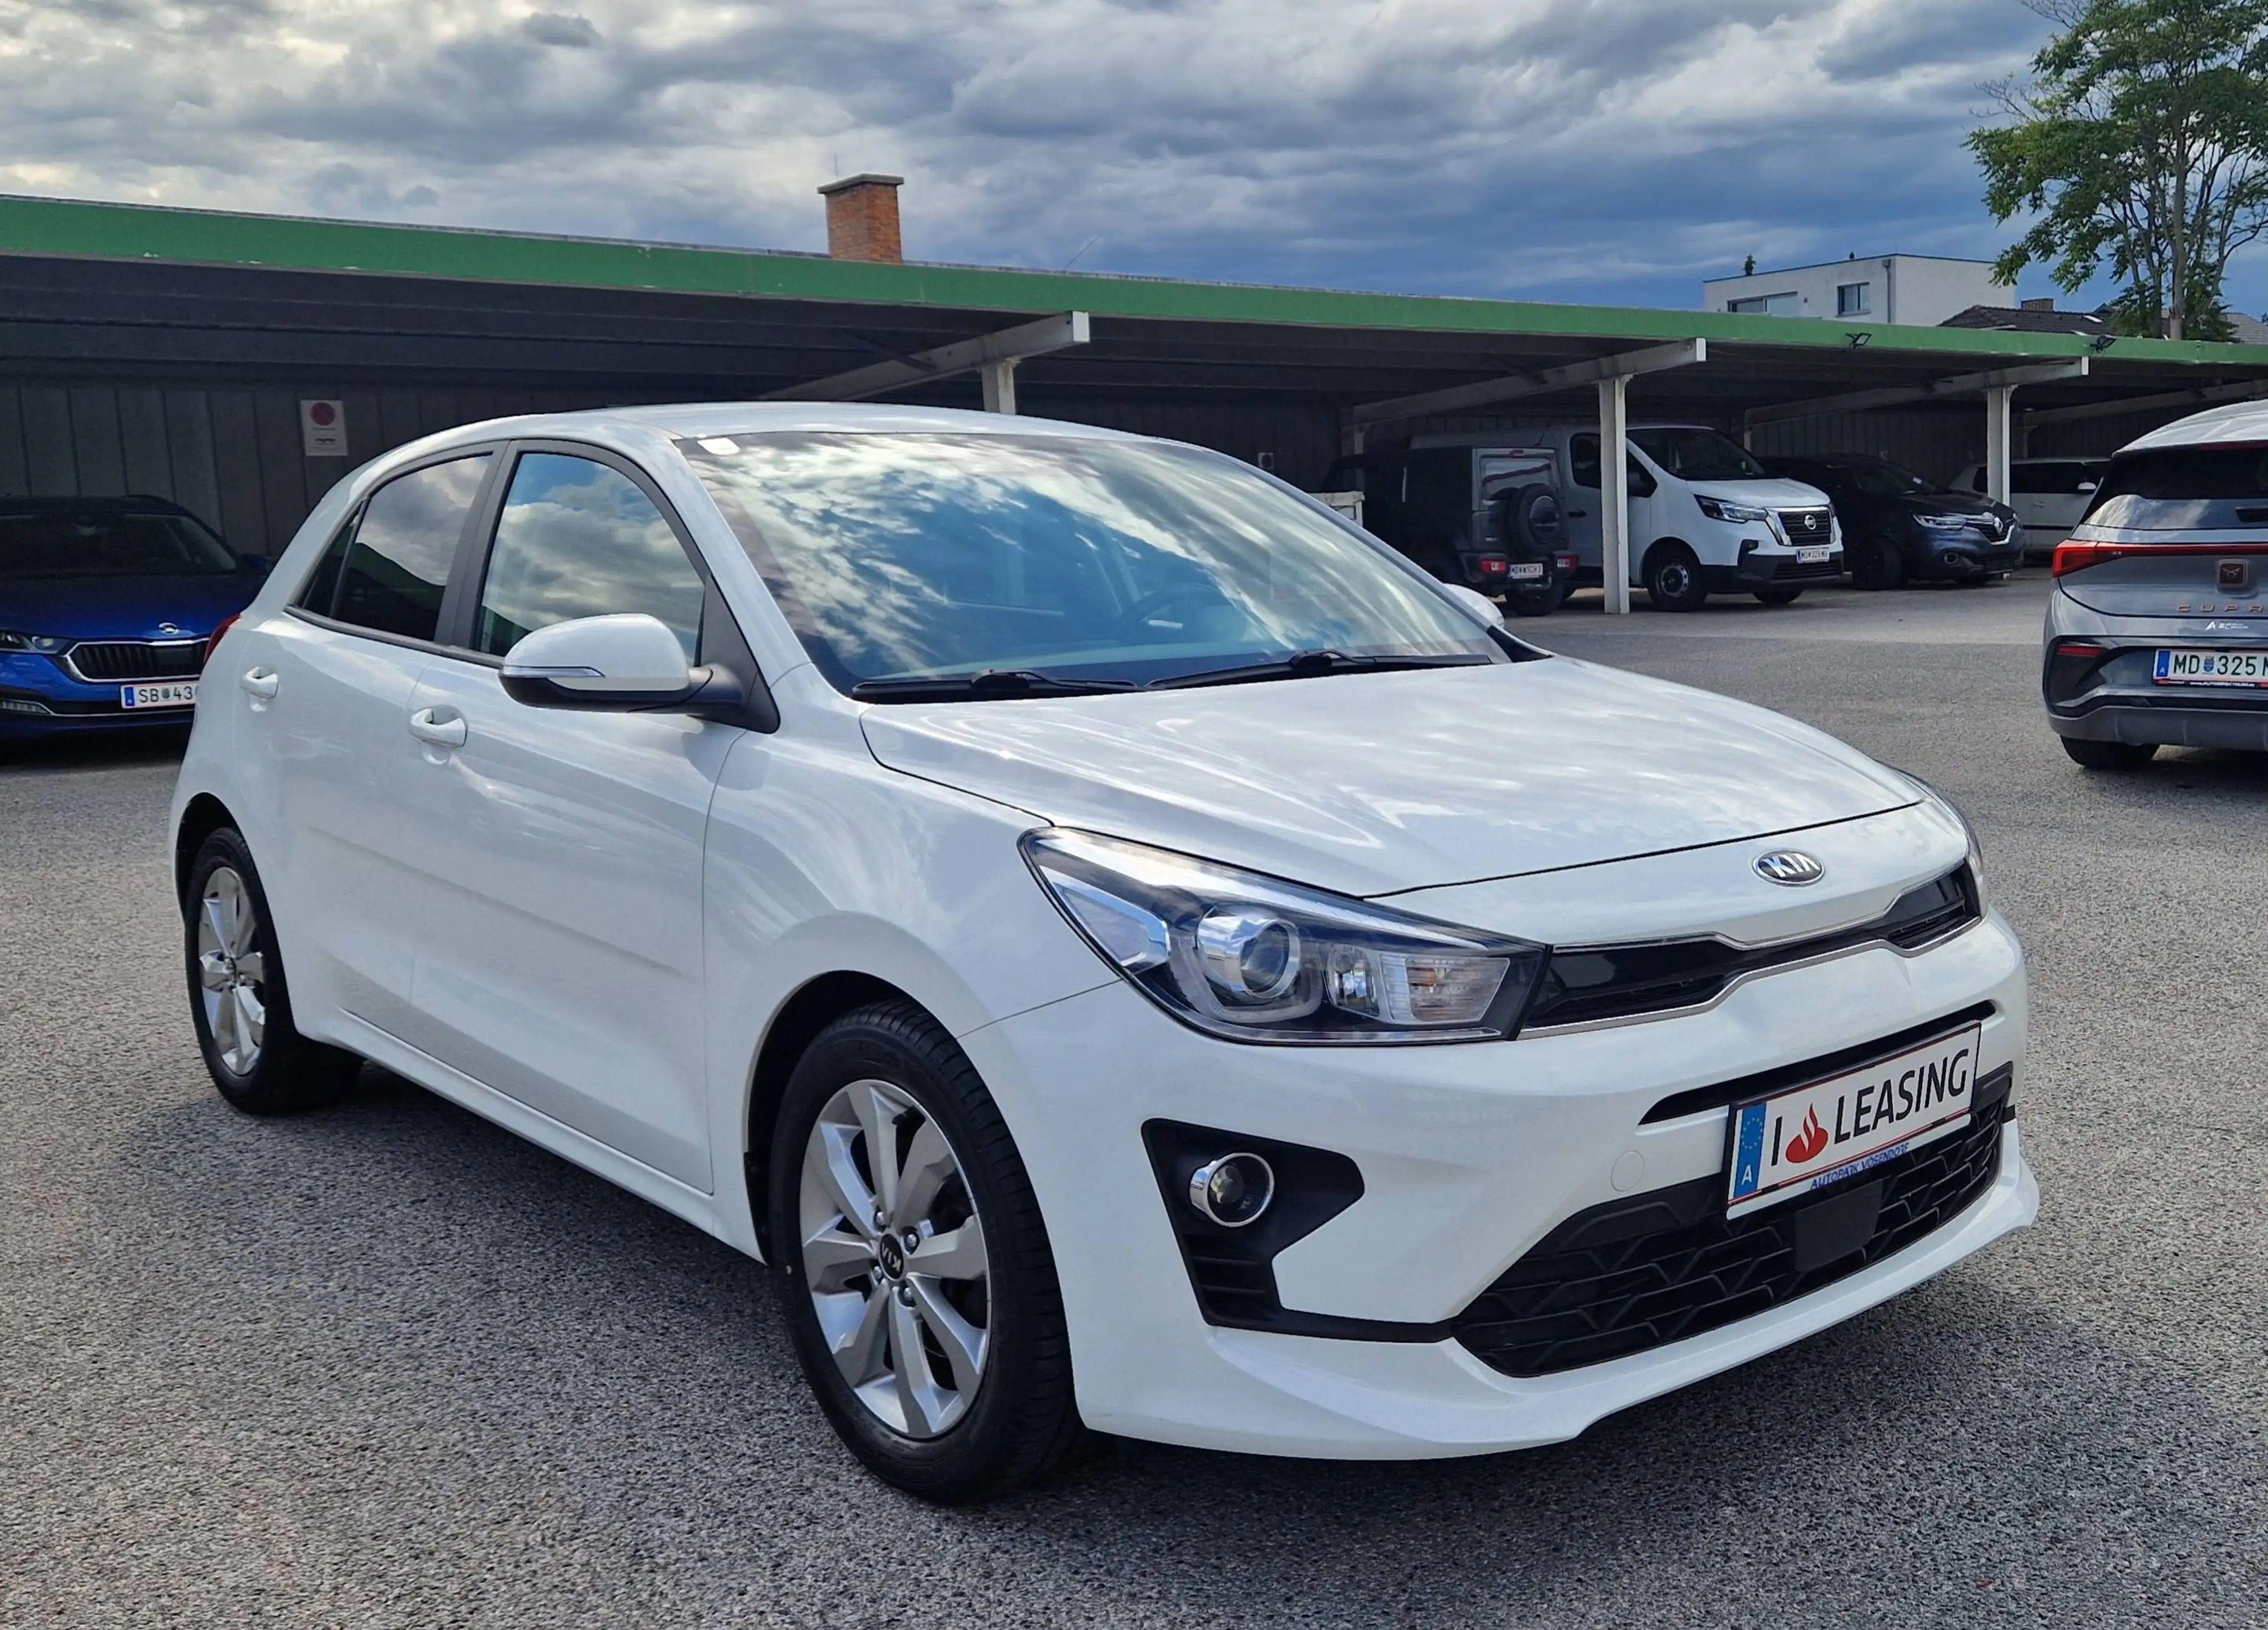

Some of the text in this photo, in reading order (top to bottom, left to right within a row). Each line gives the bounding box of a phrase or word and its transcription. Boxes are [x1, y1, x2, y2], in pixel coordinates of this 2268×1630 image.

[2174, 654, 2200, 674] MD
[139, 688, 159, 703] SB
[1771, 1048, 1969, 1167] I LEASING
[1741, 1164, 1752, 1185] A
[1810, 1162, 1860, 1190] AUTOPARK
